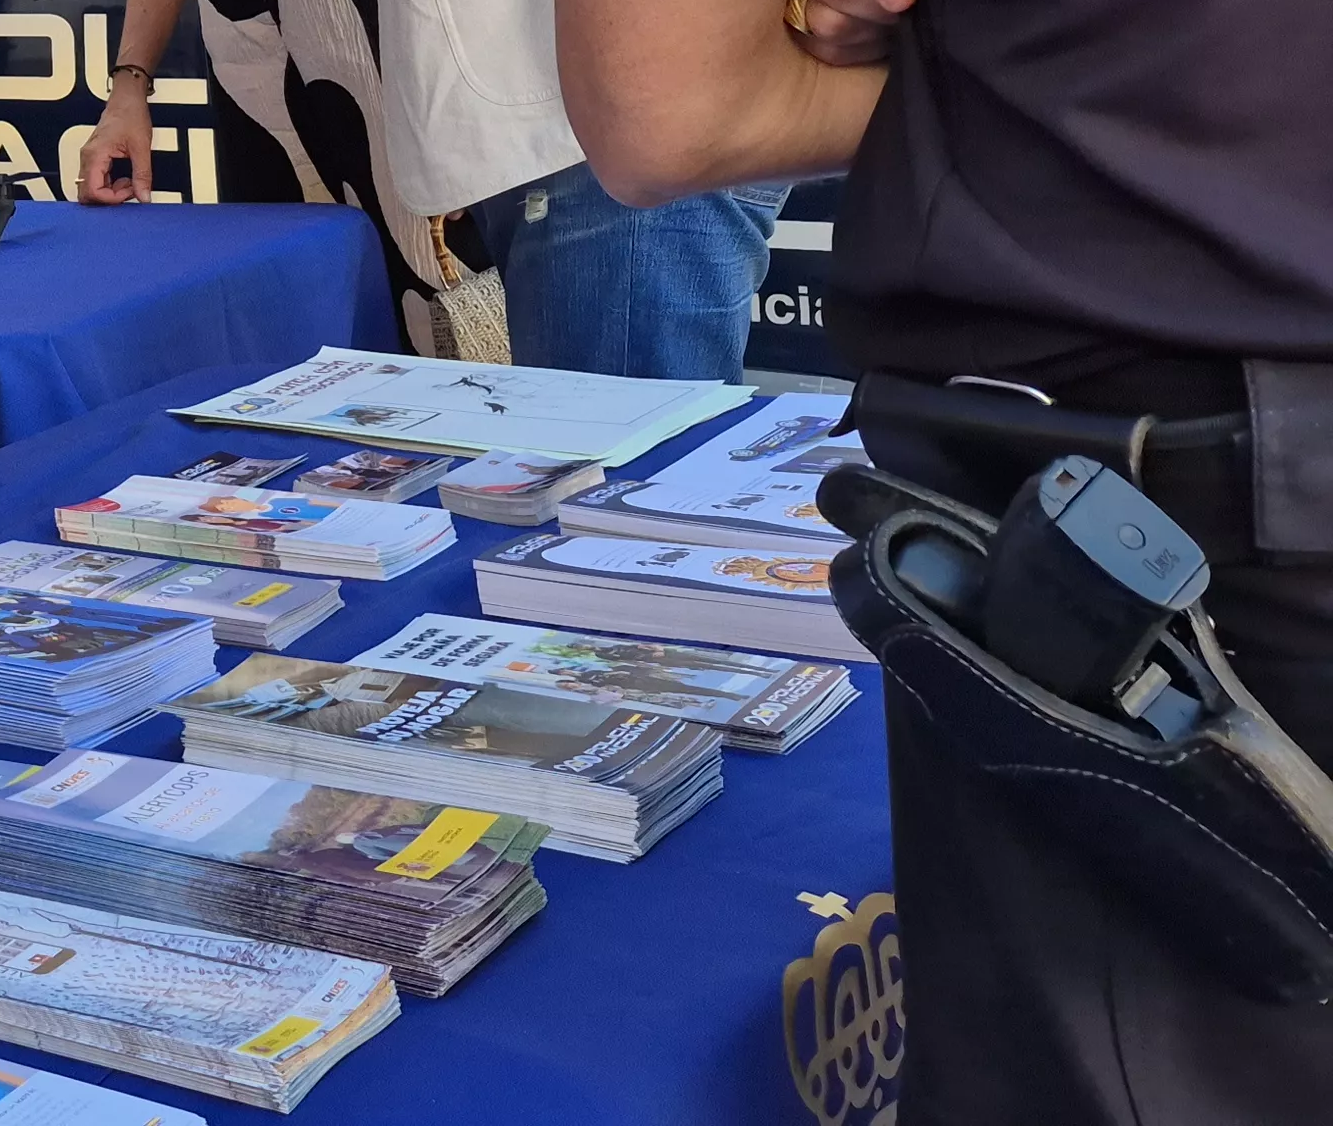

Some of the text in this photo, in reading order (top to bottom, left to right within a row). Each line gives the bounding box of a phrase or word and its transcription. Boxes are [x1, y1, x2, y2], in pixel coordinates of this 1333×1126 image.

[380, 628, 445, 660] VIAJE POR
[412, 634, 463, 660] ESPAÑA
[431, 635, 495, 668] DE FORMA
[462, 641, 515, 668] SEGURA
[782, 668, 833, 706] NACIONAL
[411, 687, 480, 734] HOGAR
[600, 715, 661, 759] NACIONAL
[50, 769, 92, 793] CNDES
[122, 769, 210, 825] ALERTCOPS
